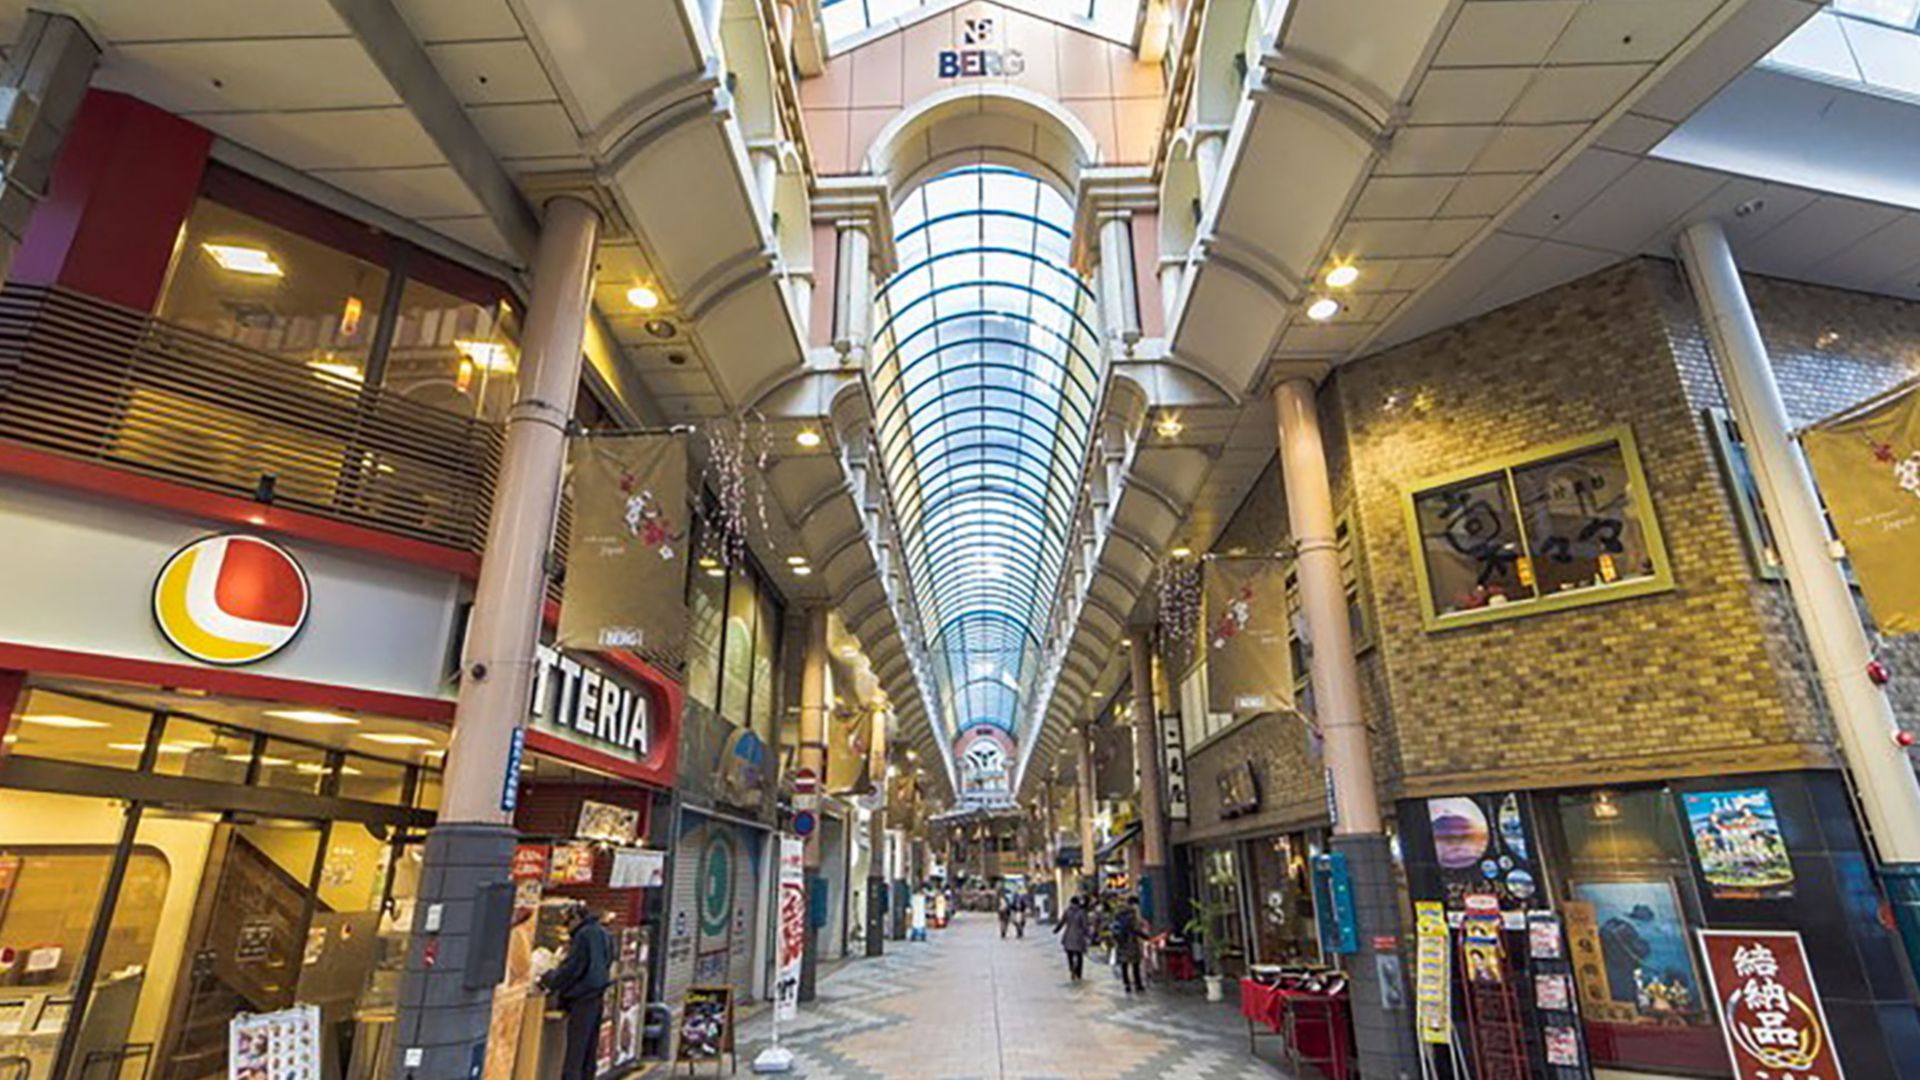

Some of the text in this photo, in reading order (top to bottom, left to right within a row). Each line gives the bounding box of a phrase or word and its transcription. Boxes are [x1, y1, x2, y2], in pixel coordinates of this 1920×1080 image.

[938, 50, 1025, 78] BERG
[533, 644, 648, 754] TTERIA
[1732, 942, 1799, 1046] 結納品
